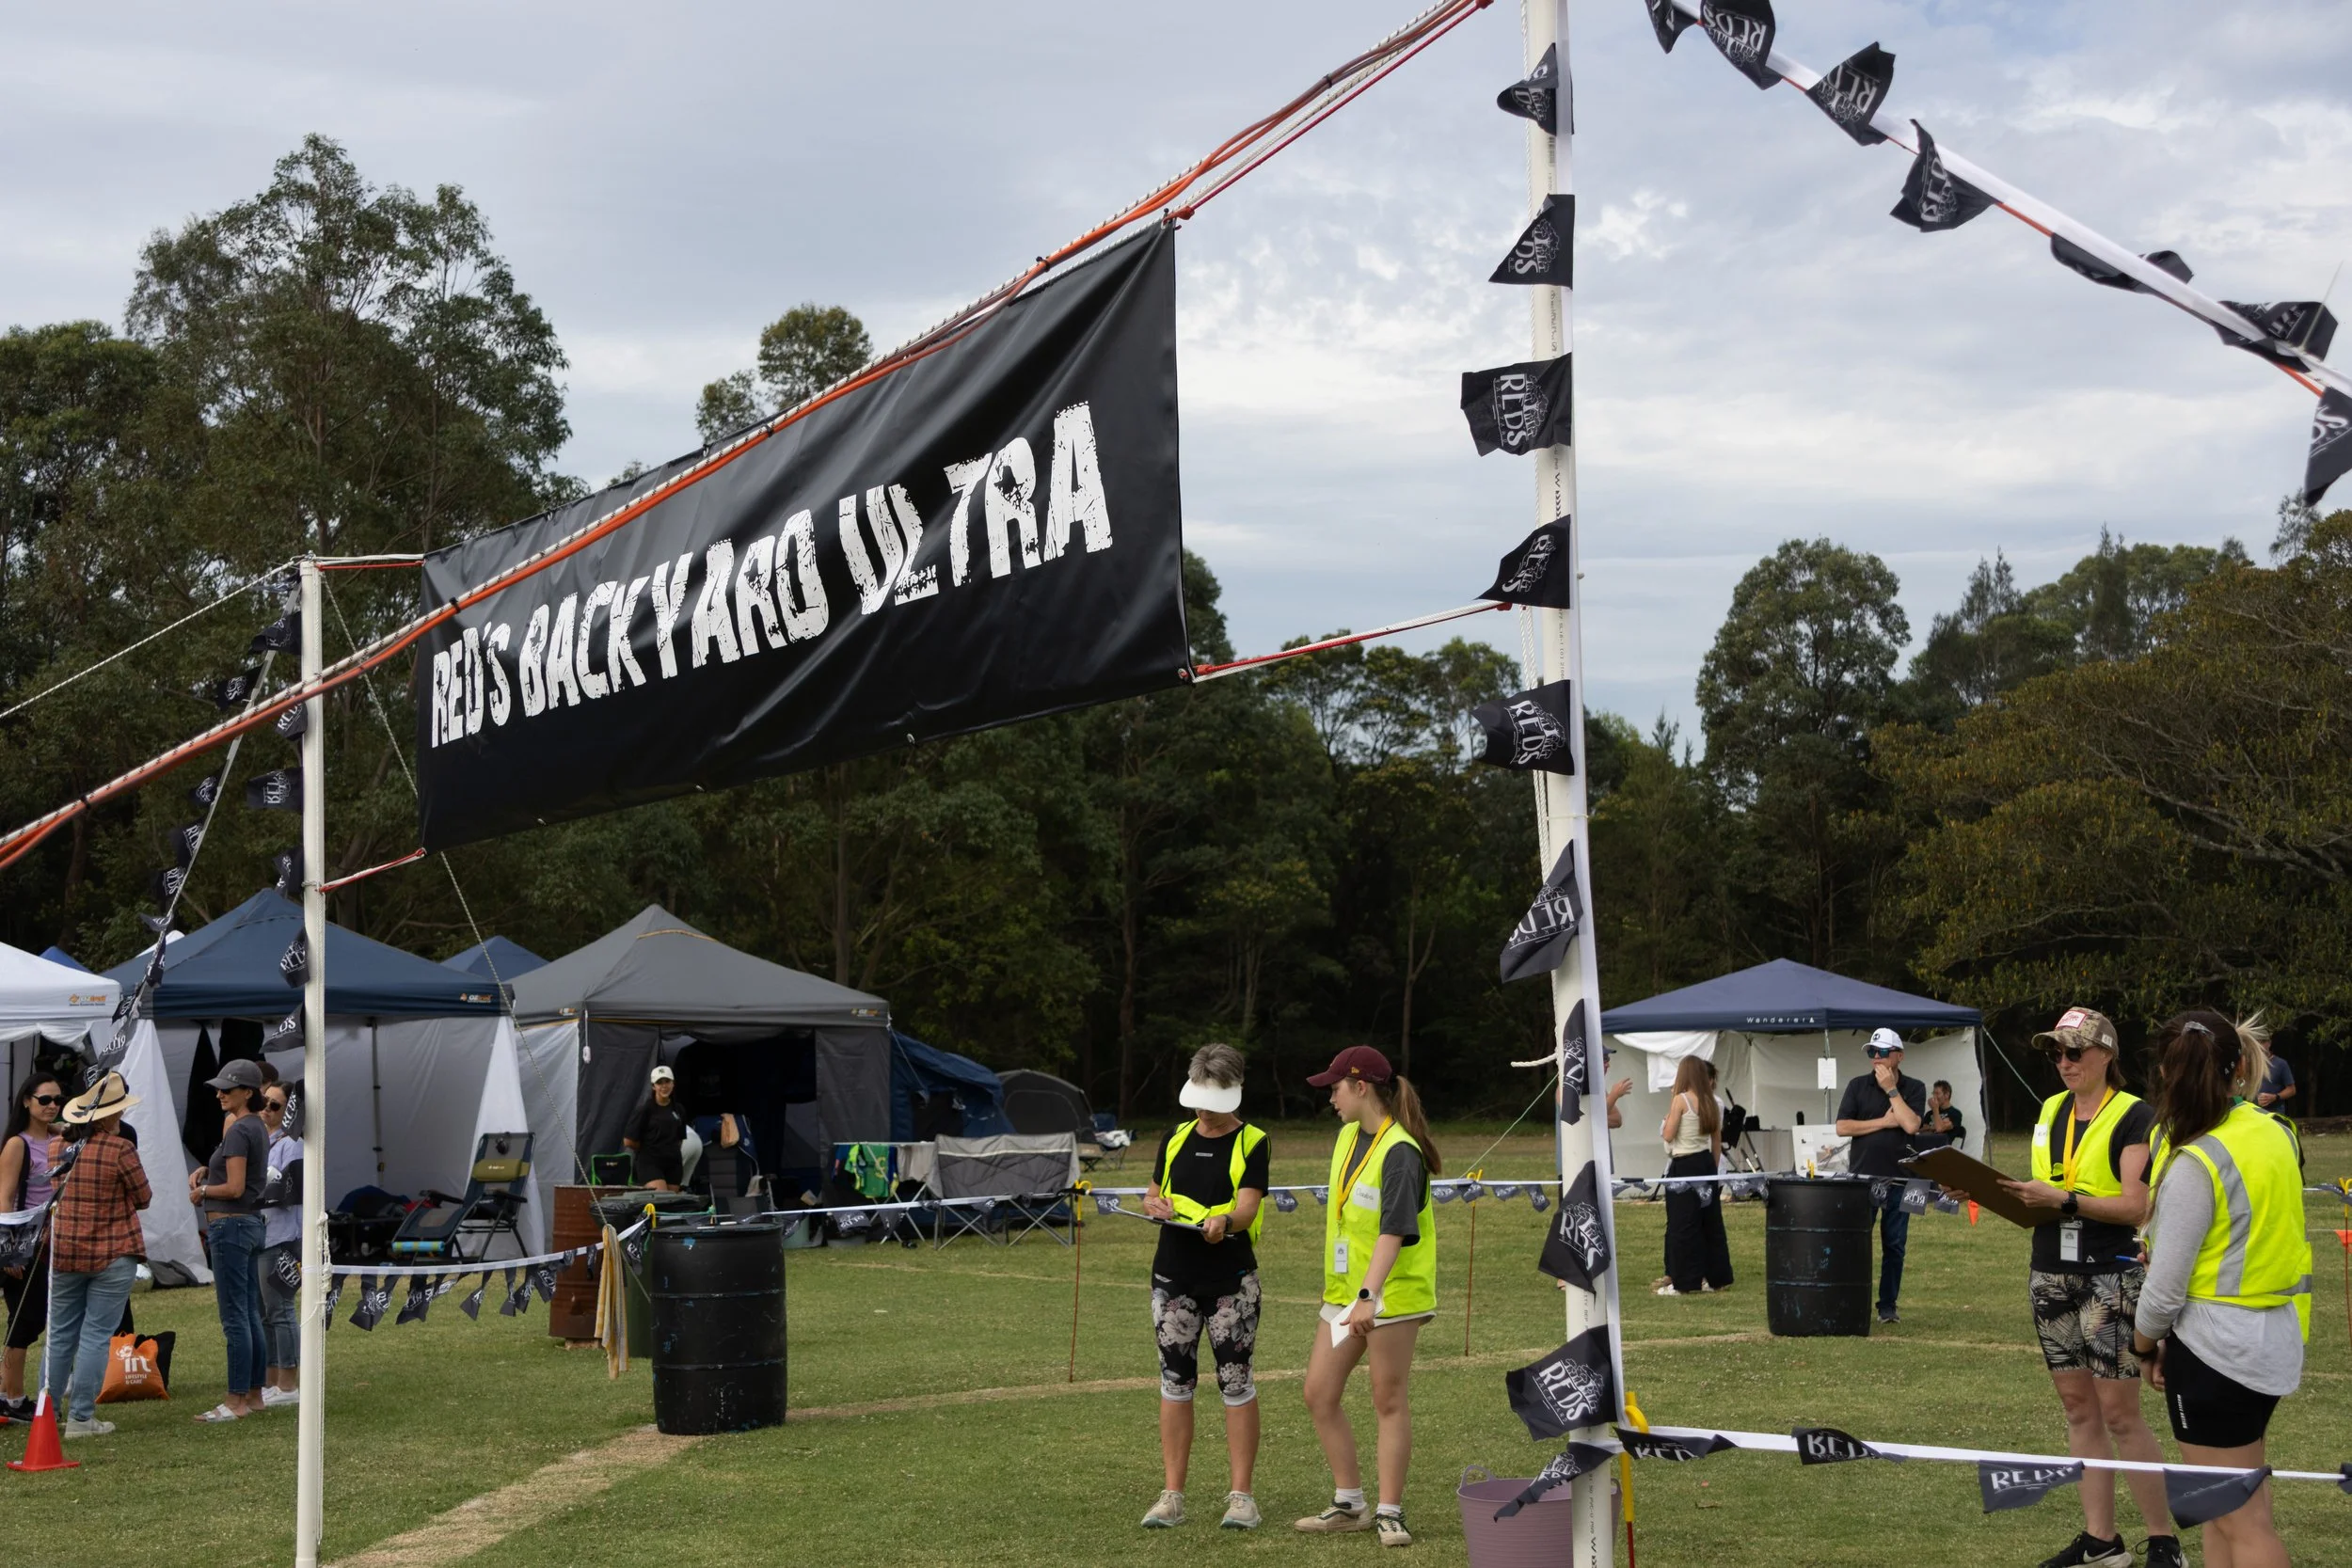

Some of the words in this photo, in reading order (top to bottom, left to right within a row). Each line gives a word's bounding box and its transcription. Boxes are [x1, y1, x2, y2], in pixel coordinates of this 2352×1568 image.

[1703, 5, 1767, 52] REDS
[1826, 64, 1878, 113] RED
[1515, 241, 1540, 274] DS
[1500, 373, 1528, 447] REDS
[431, 621, 512, 749] RED'S
[519, 509, 830, 718] BACKYARD
[838, 401, 1112, 615] ULTRA
[1509, 700, 1547, 764] REDS
[166, 867, 180, 895] REDS
[280, 950, 306, 971] RED
[1539, 1361, 1592, 1421] REDS
